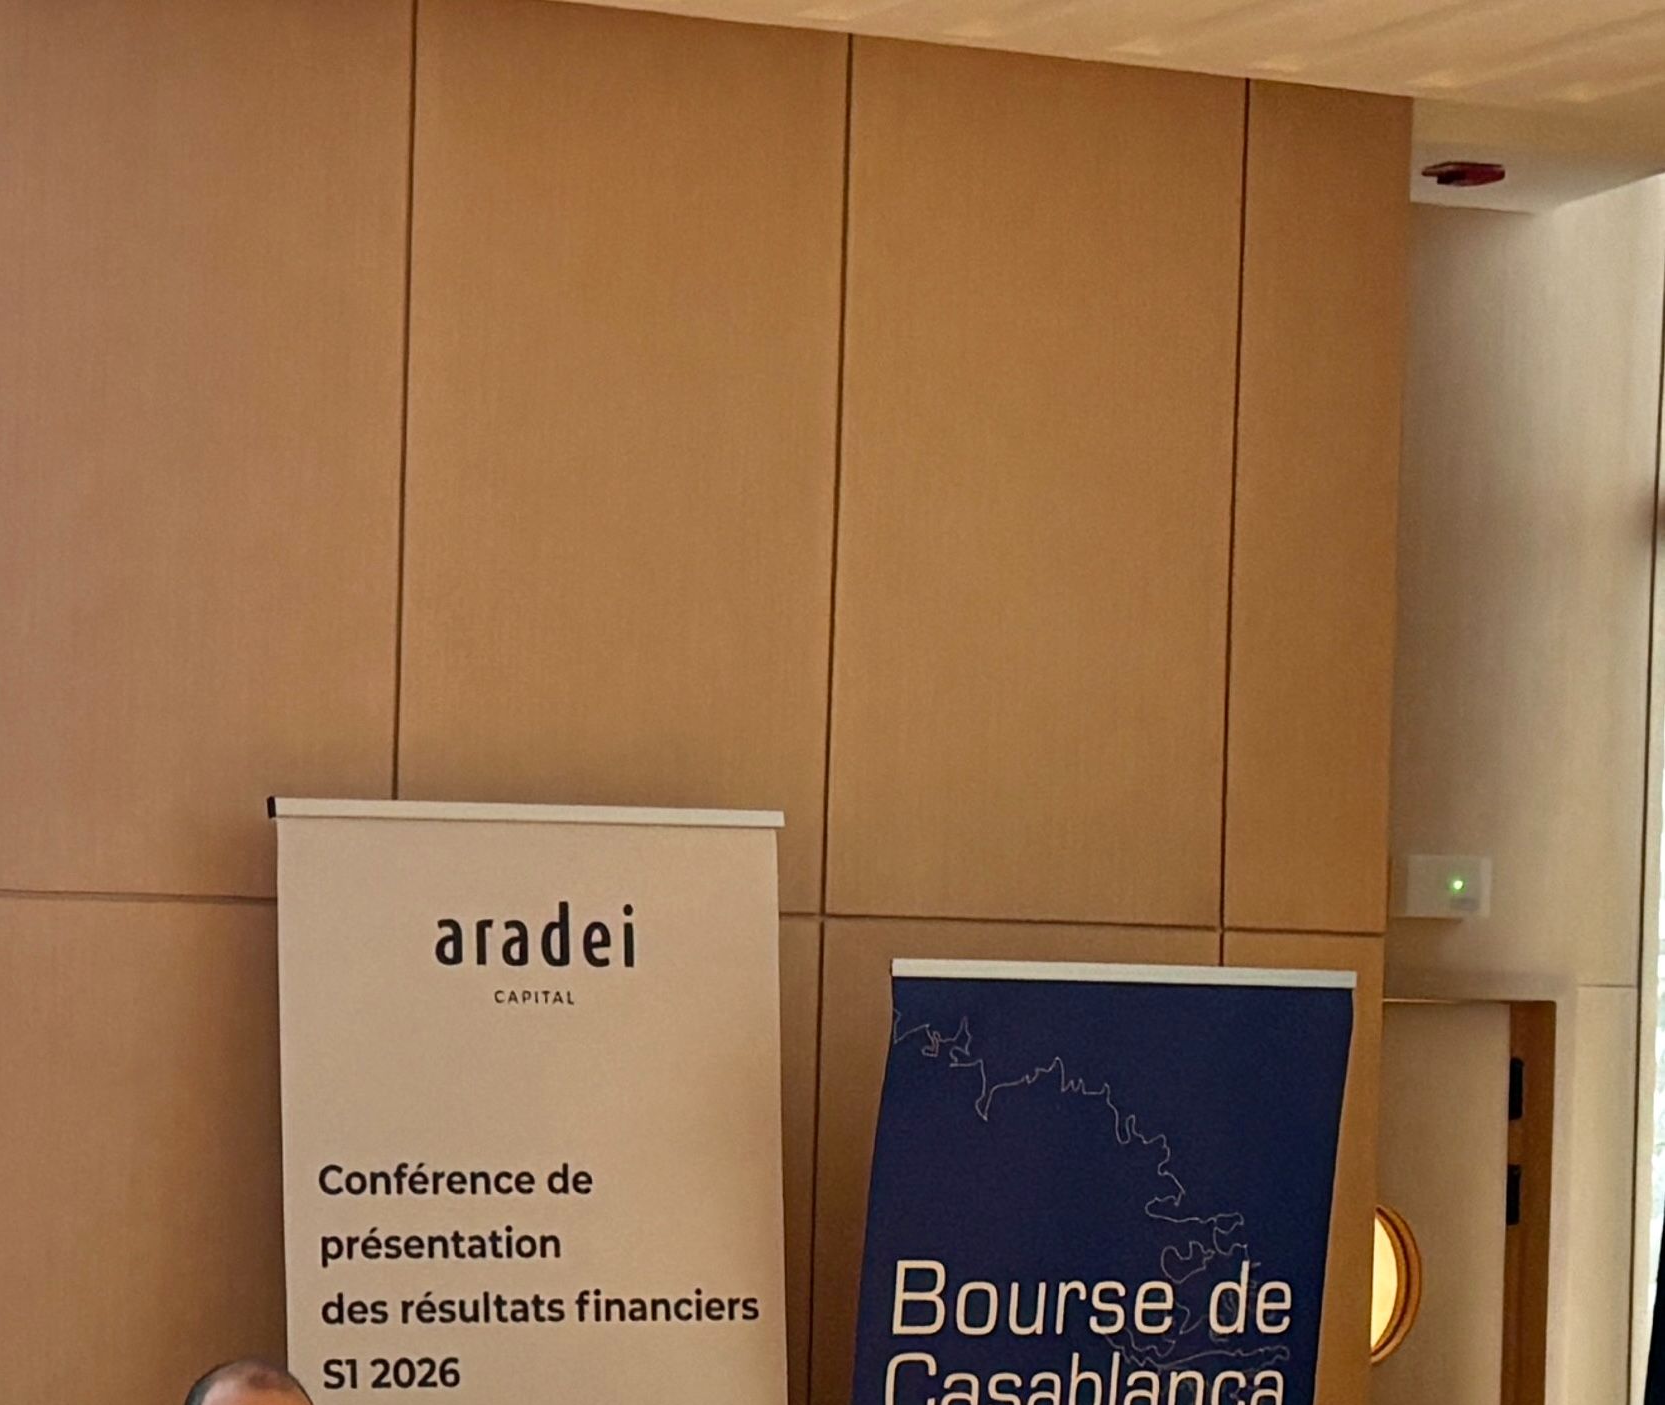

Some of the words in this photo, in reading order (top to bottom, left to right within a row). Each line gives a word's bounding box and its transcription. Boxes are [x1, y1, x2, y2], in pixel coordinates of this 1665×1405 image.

[435, 901, 634, 967] aradei
[494, 990, 574, 1005] CAPITAL
[319, 1163, 535, 1195] Conférence
[547, 1163, 592, 1194] de
[321, 1225, 560, 1268] présentation
[322, 1292, 388, 1324] des
[402, 1291, 565, 1324] résultats
[575, 1288, 759, 1322] financiers
[892, 1260, 1174, 1335] Bourse
[1209, 1260, 1291, 1334] de
[324, 1359, 357, 1389] S1
[371, 1357, 460, 1388] 2026
